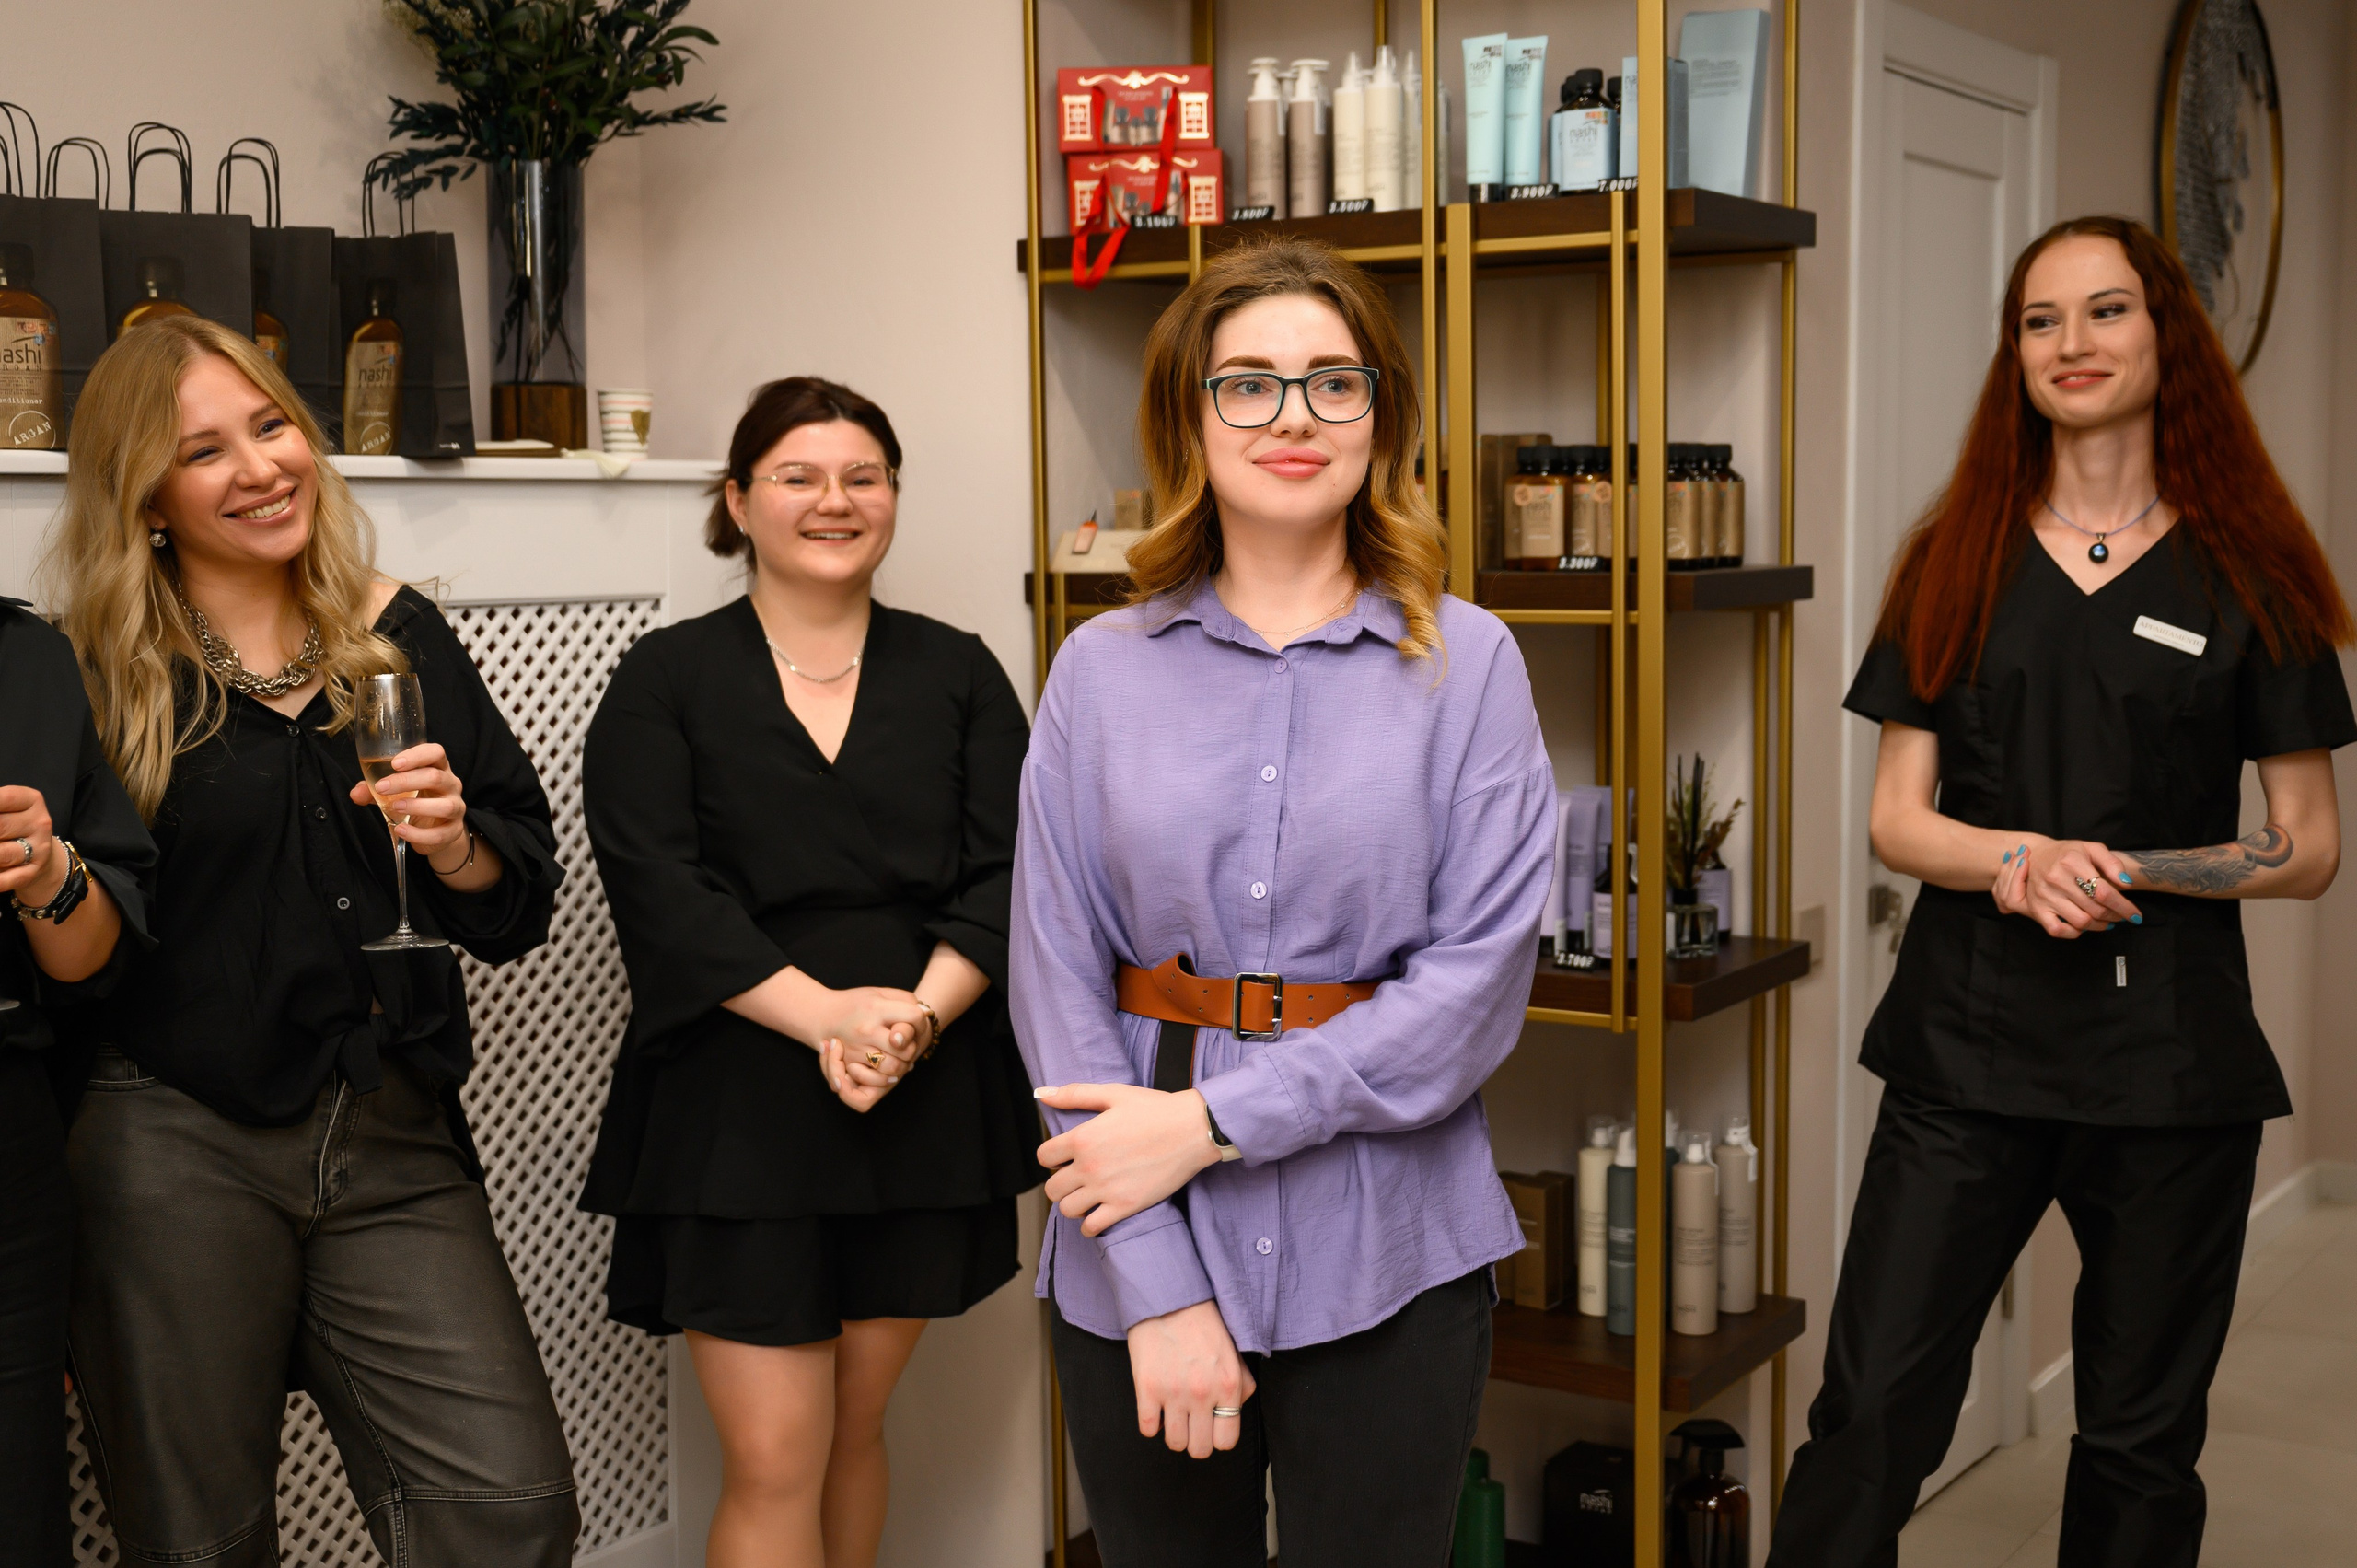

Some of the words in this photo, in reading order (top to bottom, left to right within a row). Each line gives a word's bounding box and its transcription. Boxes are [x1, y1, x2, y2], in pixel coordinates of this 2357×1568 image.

[0, 343, 41, 364] ashi
[358, 364, 392, 382] nashi
[14, 421, 52, 446] ARGAN
[362, 430, 391, 452] ARGAN
[2139, 621, 2204, 647] APPARTAMENTO
